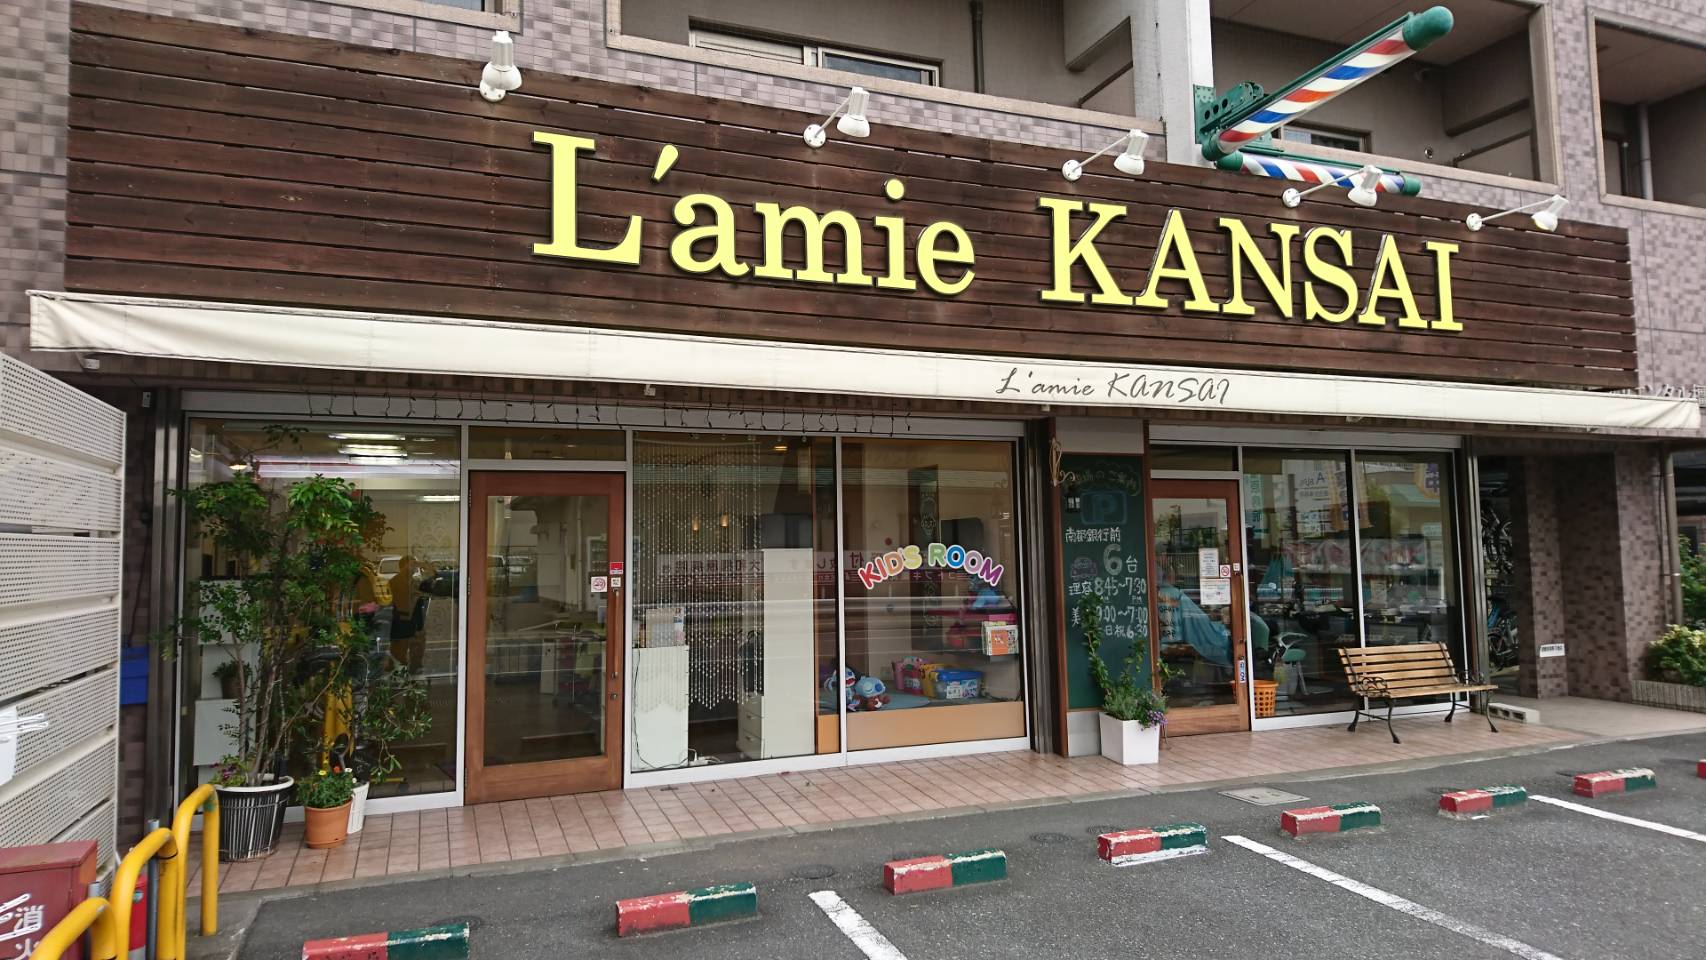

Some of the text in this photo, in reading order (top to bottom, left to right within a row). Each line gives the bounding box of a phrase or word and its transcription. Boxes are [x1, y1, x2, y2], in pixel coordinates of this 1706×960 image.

[532, 130, 1464, 332] L'amie KANSAI
[996, 367, 1095, 396] L'amie
[857, 542, 1005, 590] KID'S ROOM
[1103, 543, 1123, 576] 6
